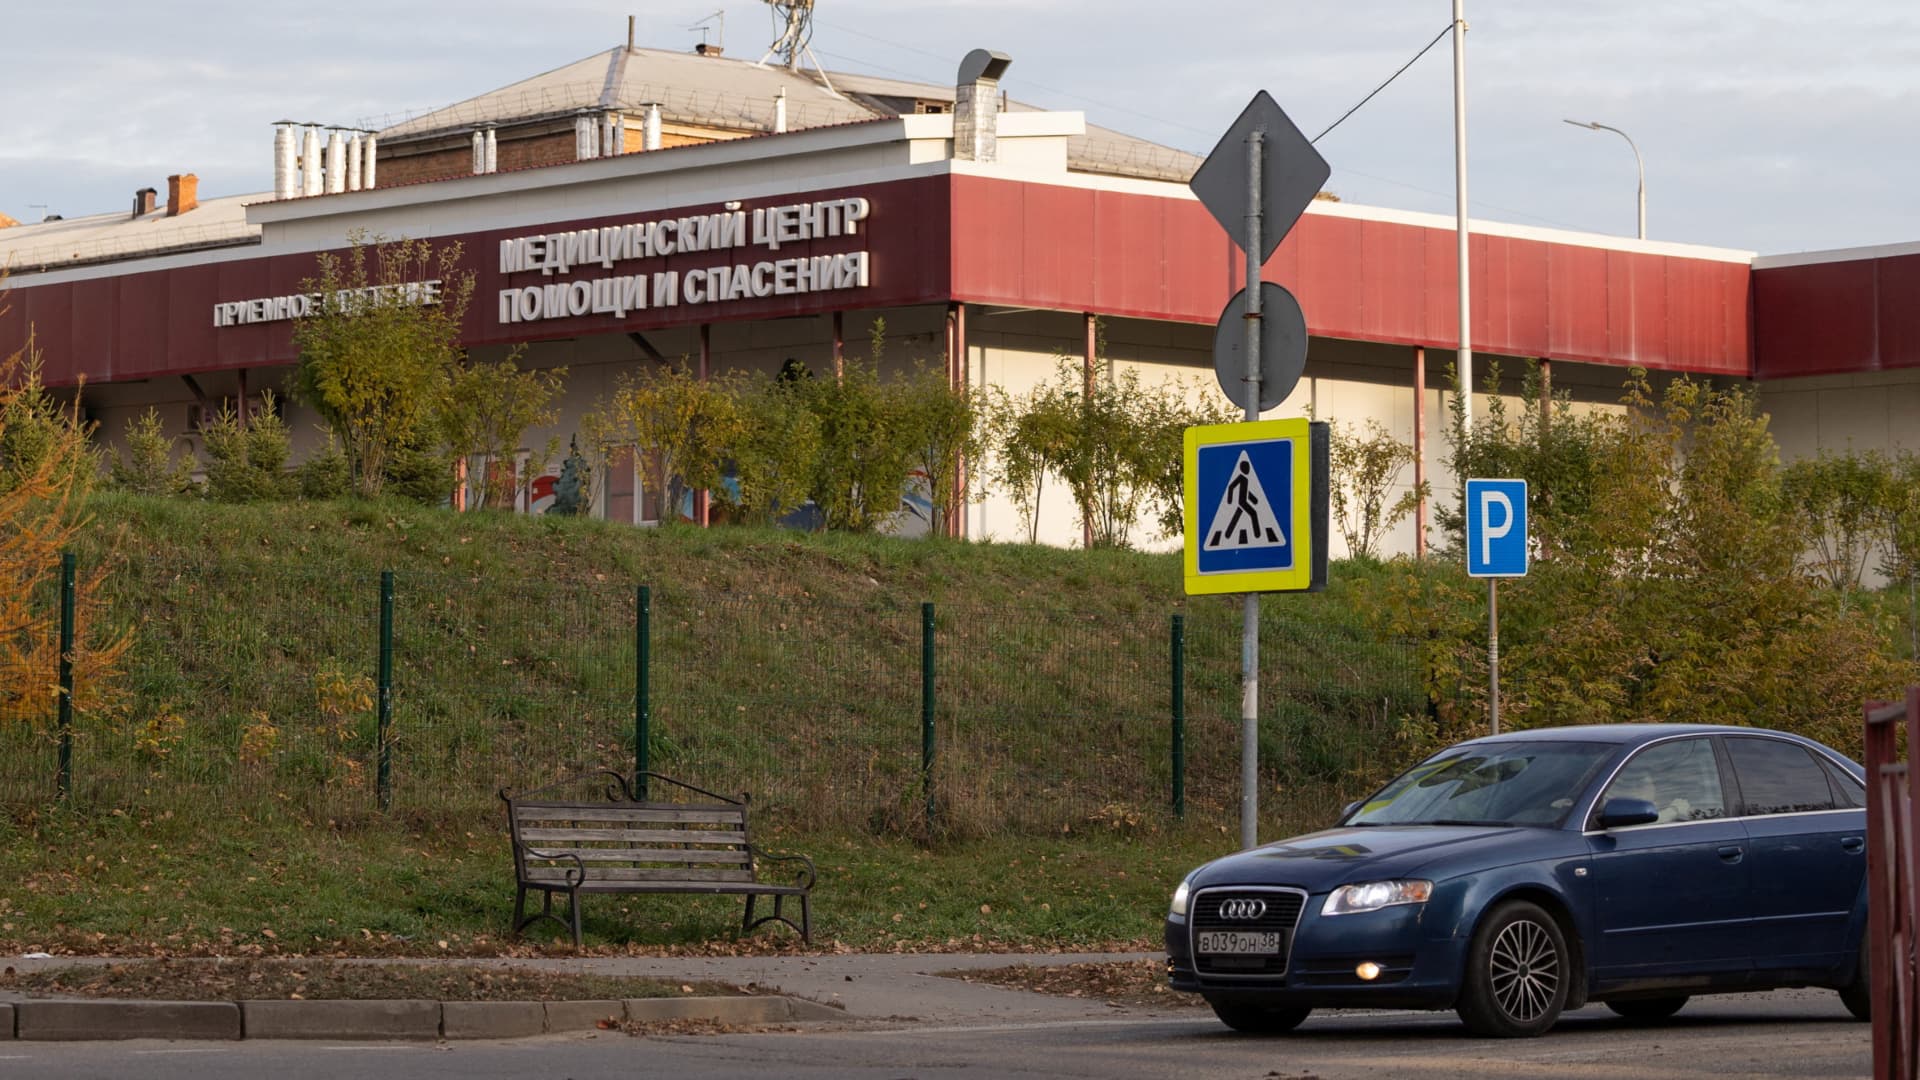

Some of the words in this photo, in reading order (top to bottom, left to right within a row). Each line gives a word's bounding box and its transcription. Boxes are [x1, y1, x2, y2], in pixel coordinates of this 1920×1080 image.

[499, 201, 746, 276] МЕДИЦИНСКИЙ
[753, 197, 870, 250] ЦЕНТР
[213, 292, 323, 328] ПРИЕМНОЕ
[499, 274, 648, 324] ПОМОЩИ
[653, 271, 679, 308] И
[683, 251, 870, 305] СПАСЕНИЯ
[1481, 490, 1514, 565] P
